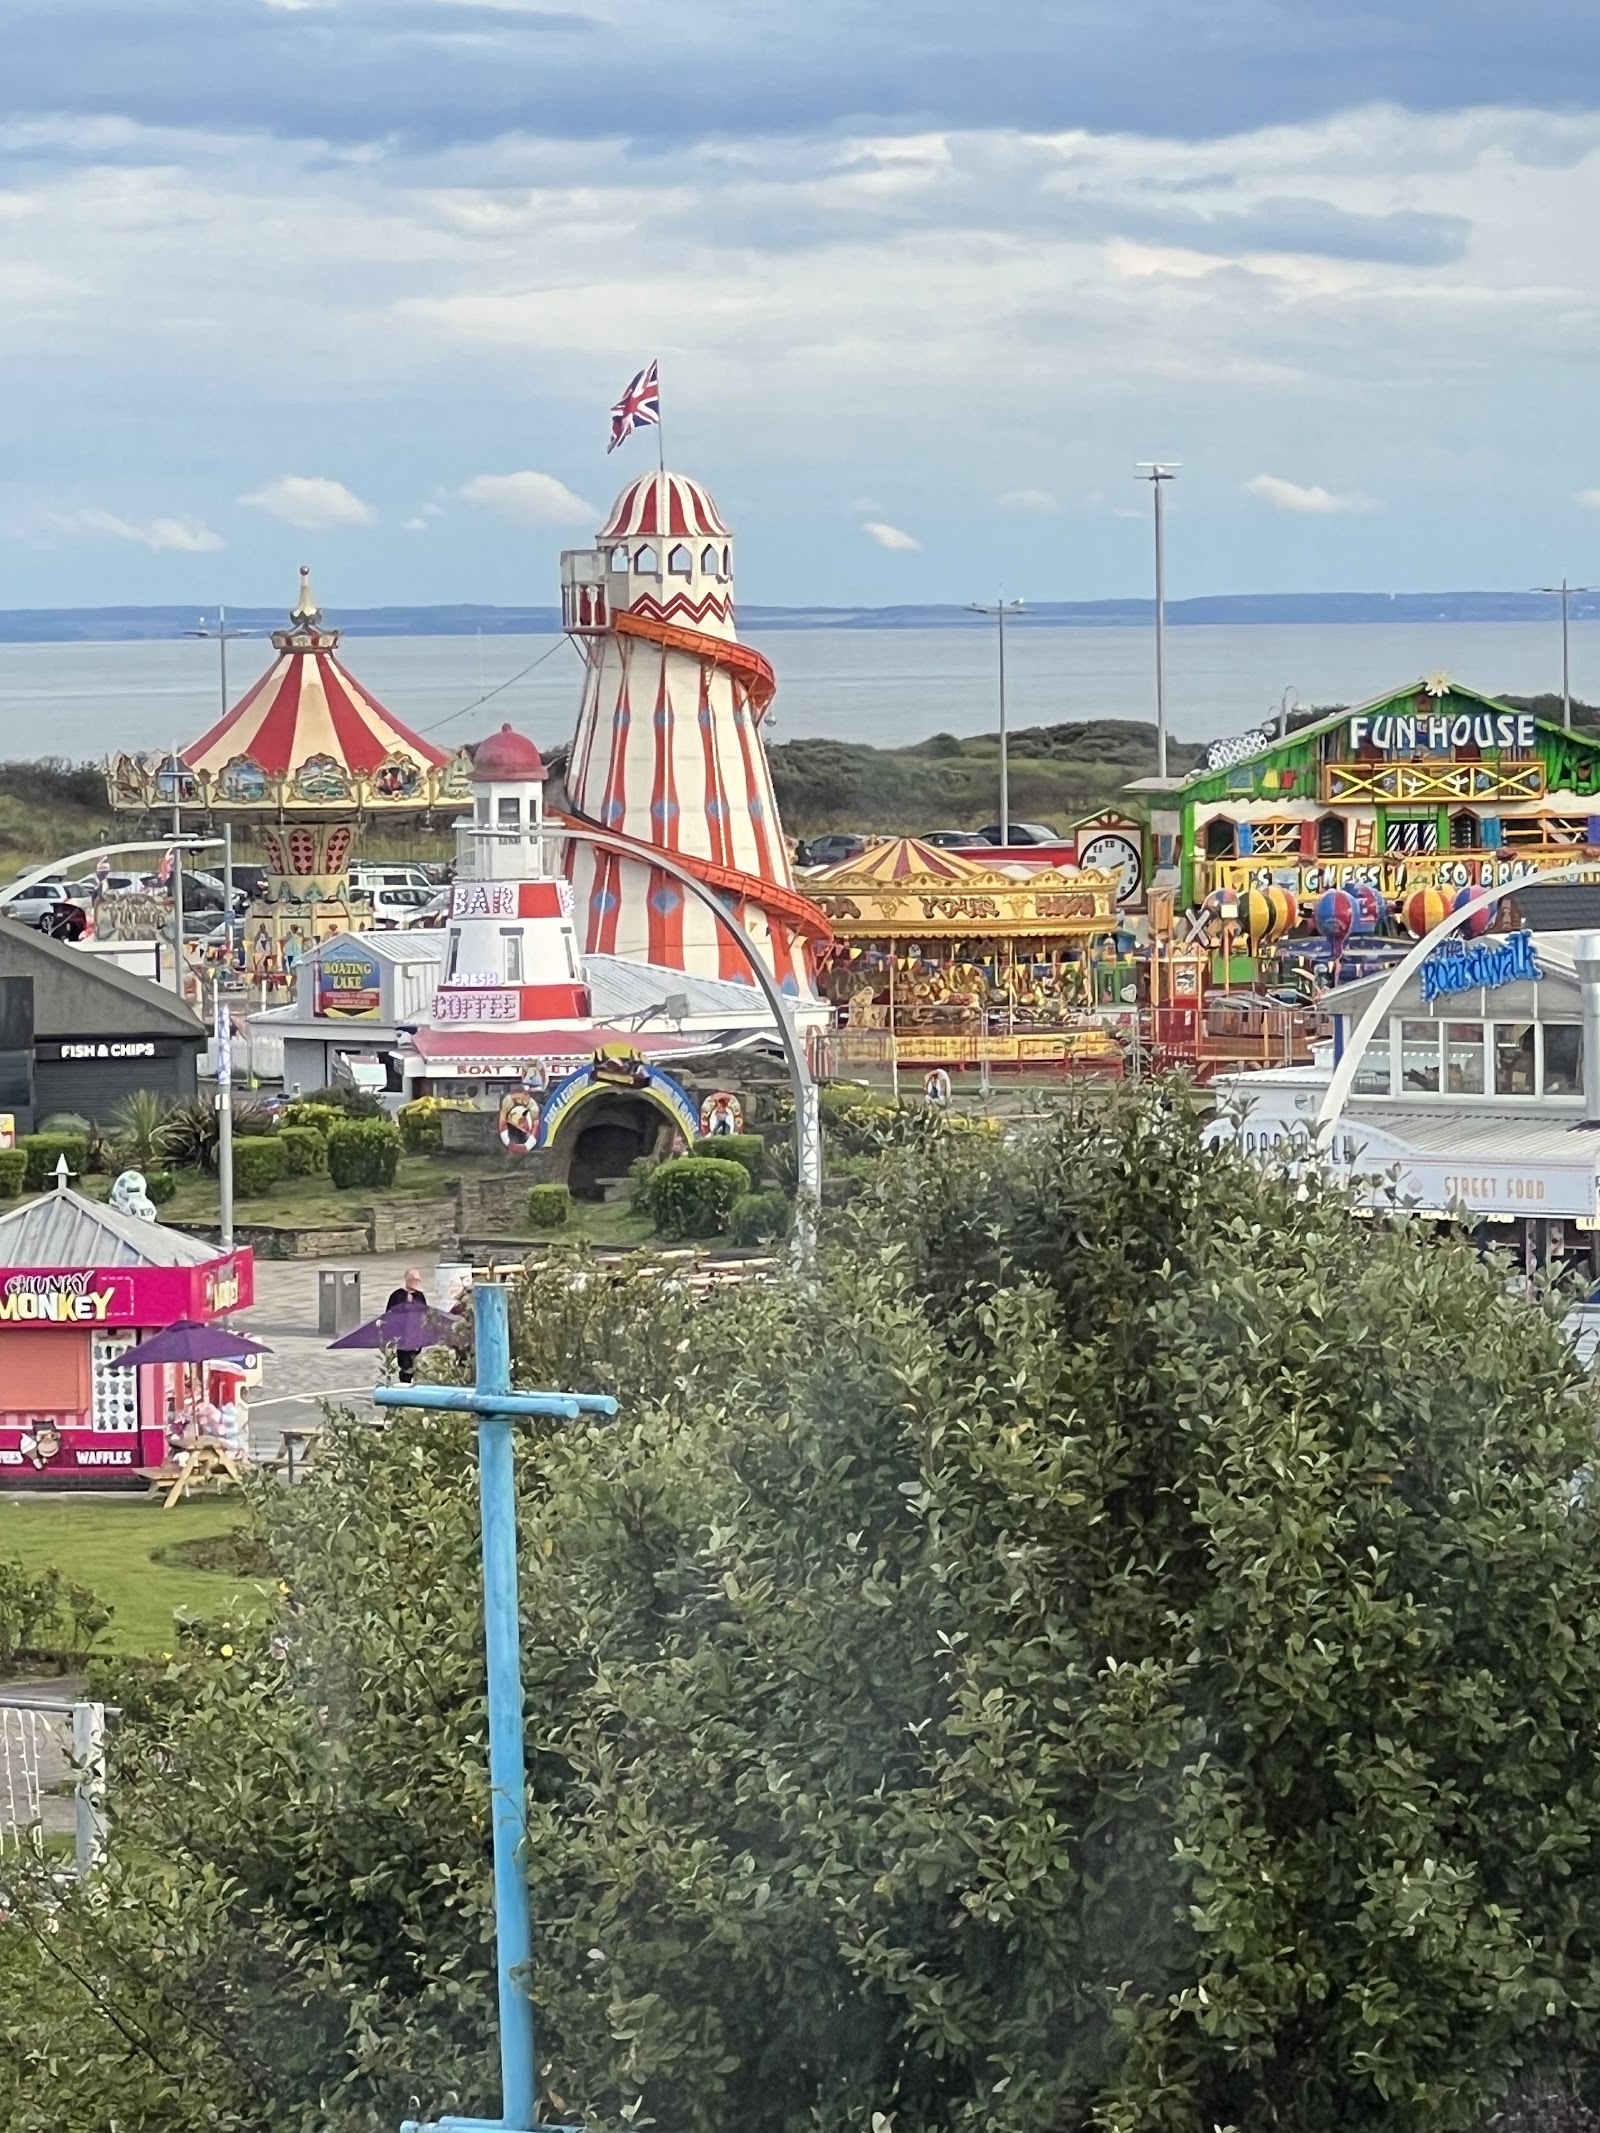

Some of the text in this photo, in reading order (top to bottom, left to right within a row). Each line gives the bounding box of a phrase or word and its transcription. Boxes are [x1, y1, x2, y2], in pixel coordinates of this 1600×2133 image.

[1350, 713, 1535, 749] FUN HOUSE
[453, 886, 514, 914] BAR
[323, 962, 372, 974] BOATING
[450, 973, 499, 986] FRESH
[432, 993, 516, 1020] COFFEE
[61, 1043, 155, 1058] FISH & CHIPS
[457, 1065, 502, 1075] BOAT
[1444, 1175, 1545, 1200] STREET FOOD
[4, 1270, 95, 1296] CHUNKY
[0, 1286, 116, 1321] MONKEY
[76, 1450, 132, 1465] WAFFLES
